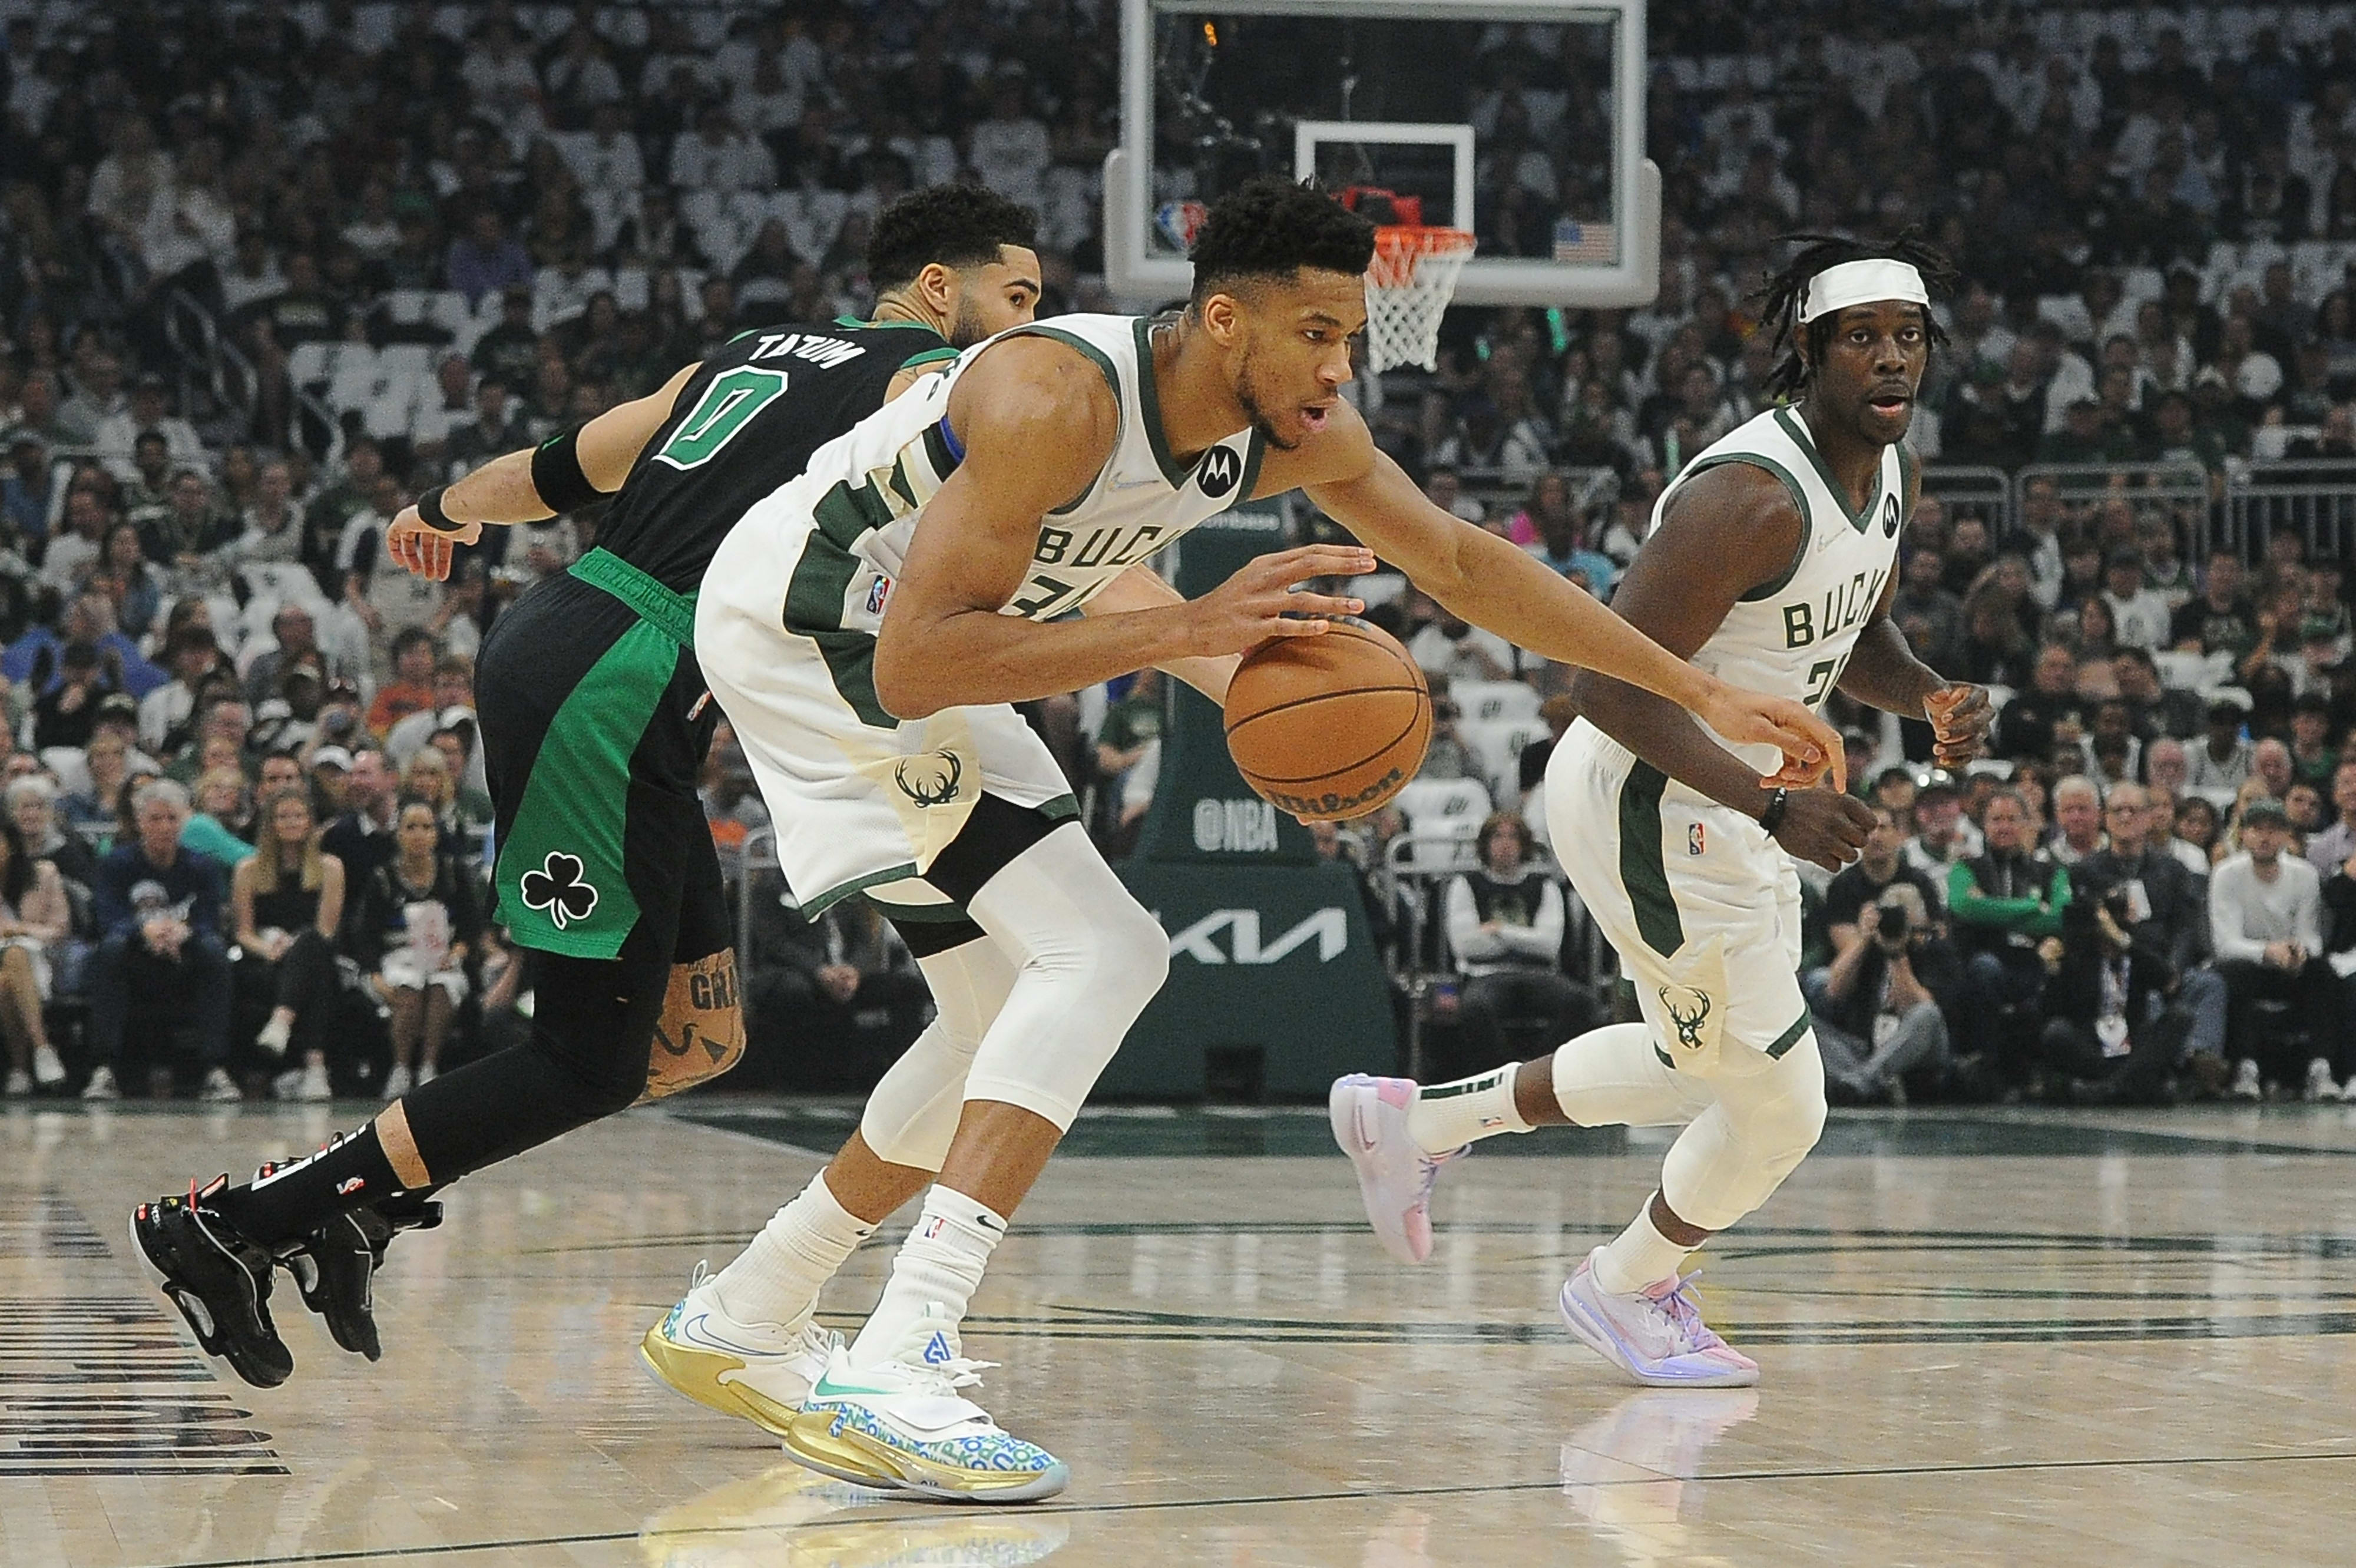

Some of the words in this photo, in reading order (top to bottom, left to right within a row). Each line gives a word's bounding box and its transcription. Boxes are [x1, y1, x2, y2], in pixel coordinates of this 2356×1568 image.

[747, 333, 866, 369] TATUM
[651, 365, 788, 470] 0
[1034, 526, 1180, 567] BUC
[1802, 652, 1849, 712] 2
[1193, 798, 1279, 852] @NBA
